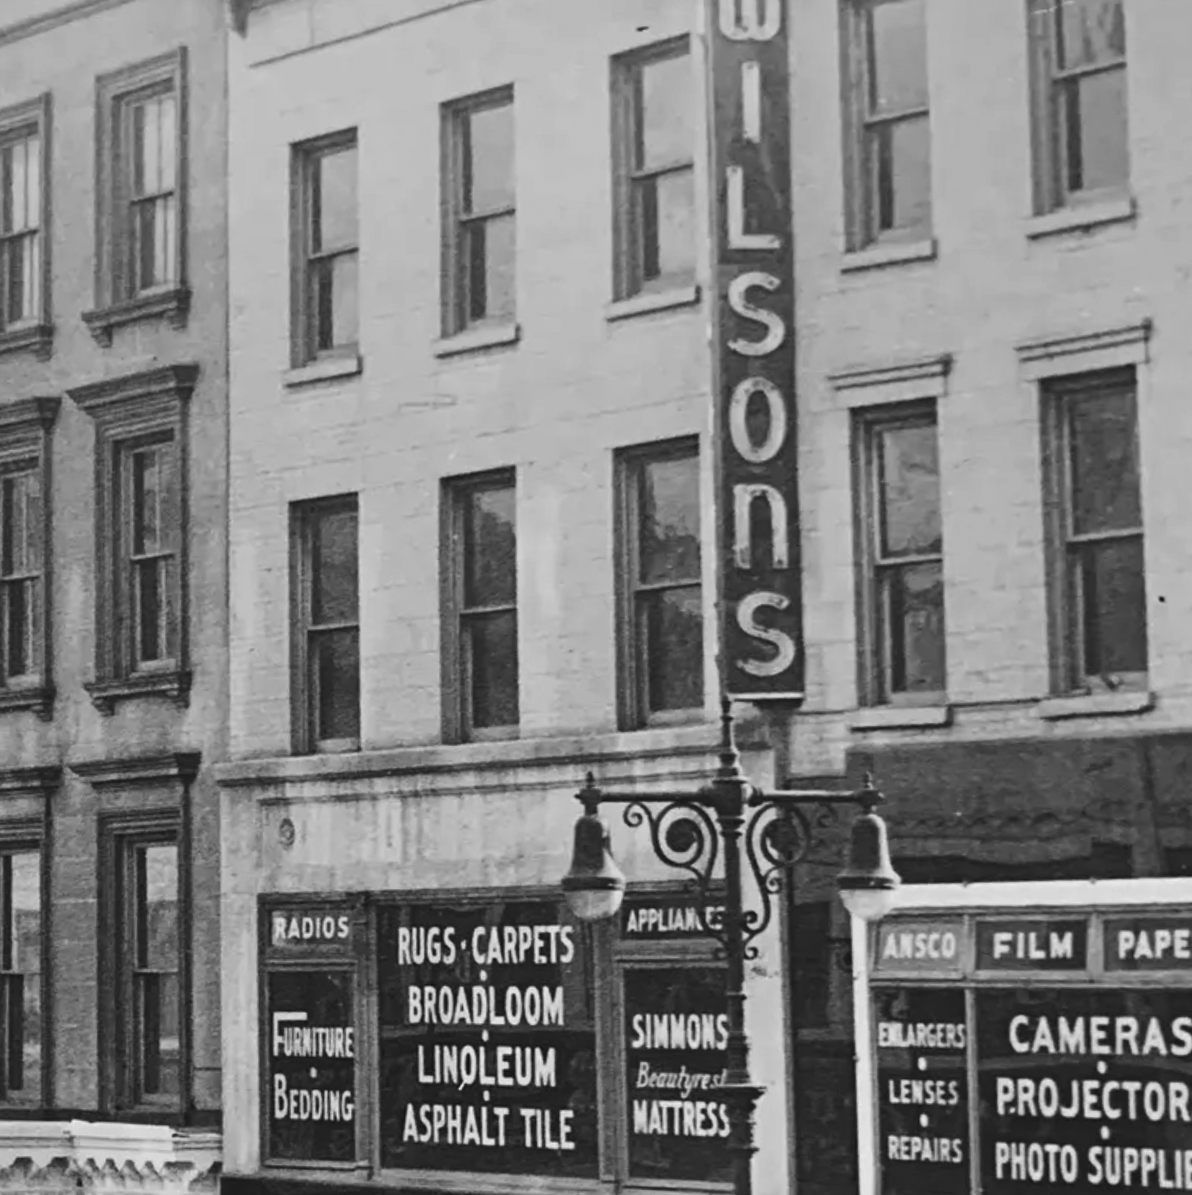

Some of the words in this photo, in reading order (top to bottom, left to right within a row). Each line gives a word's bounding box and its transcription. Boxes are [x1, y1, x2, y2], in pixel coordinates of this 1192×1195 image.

[272, 915, 350, 940] RADIOS
[626, 906, 727, 932] APPLIANES
[398, 926, 457, 966] RUGS
[471, 923, 575, 966] CARPETS
[882, 931, 956, 960] ANSCO
[992, 931, 1074, 960] FILM
[1118, 929, 1191, 960] PAPE
[408, 985, 565, 1026] BROADLOOM
[631, 1013, 729, 1051] SIMMONS
[877, 1021, 966, 1050] ENLARGERS
[1009, 1014, 1192, 1057] CAMERAS
[418, 1045, 556, 1088] LINOLEUM
[635, 1061, 728, 1100] Beautyrest
[888, 1079, 960, 1106] LENSES
[402, 1103, 509, 1147] ASPHALT
[519, 1108, 575, 1151] TILE
[632, 1100, 731, 1138] MATTRESS
[887, 1135, 963, 1163] REPAIRS
[995, 1142, 1078, 1182] PHOTO
